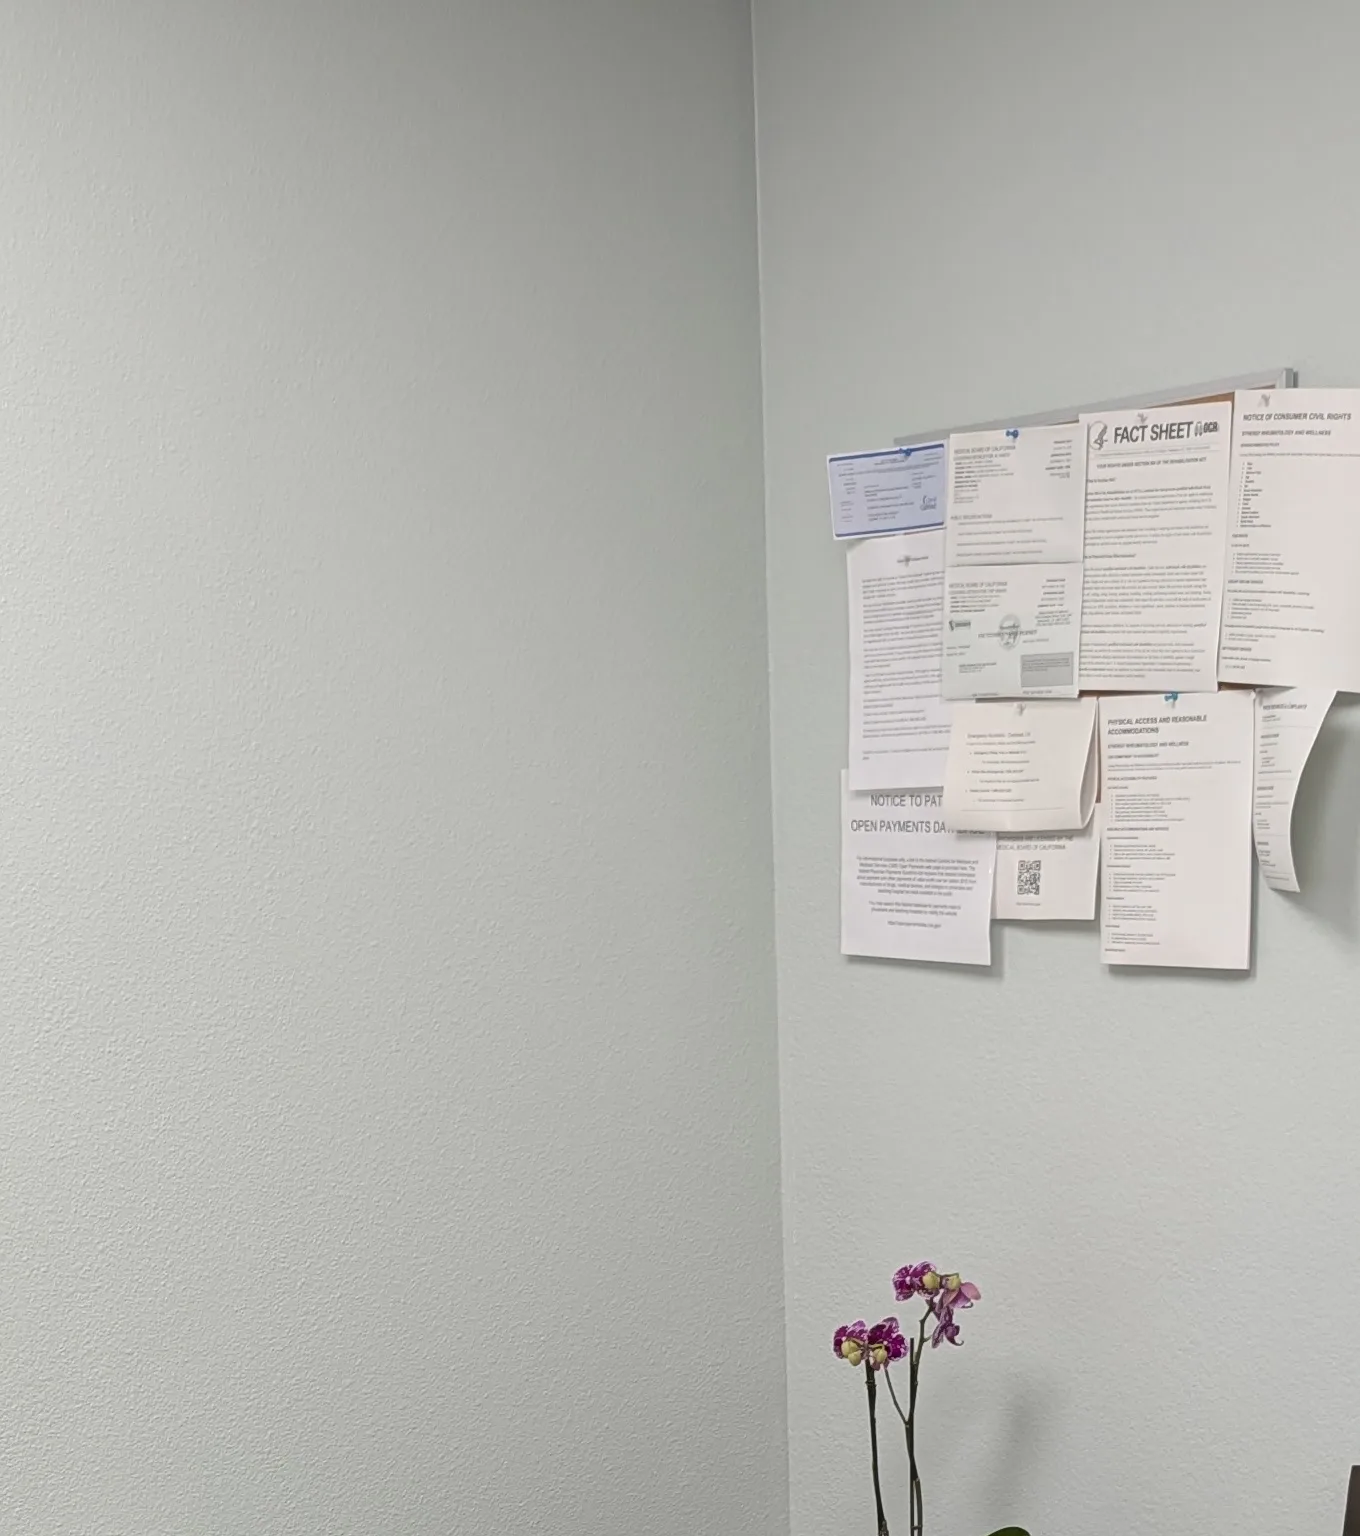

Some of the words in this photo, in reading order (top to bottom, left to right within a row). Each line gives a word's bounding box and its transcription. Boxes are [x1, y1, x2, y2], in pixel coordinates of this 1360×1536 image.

[1114, 425, 1148, 444] FACT
[1150, 421, 1194, 441] SHEET
[870, 795, 905, 807] NOTICE
[910, 795, 922, 807] TO
[851, 820, 877, 832] OPEN
[879, 820, 931, 834] PAYMENTS
